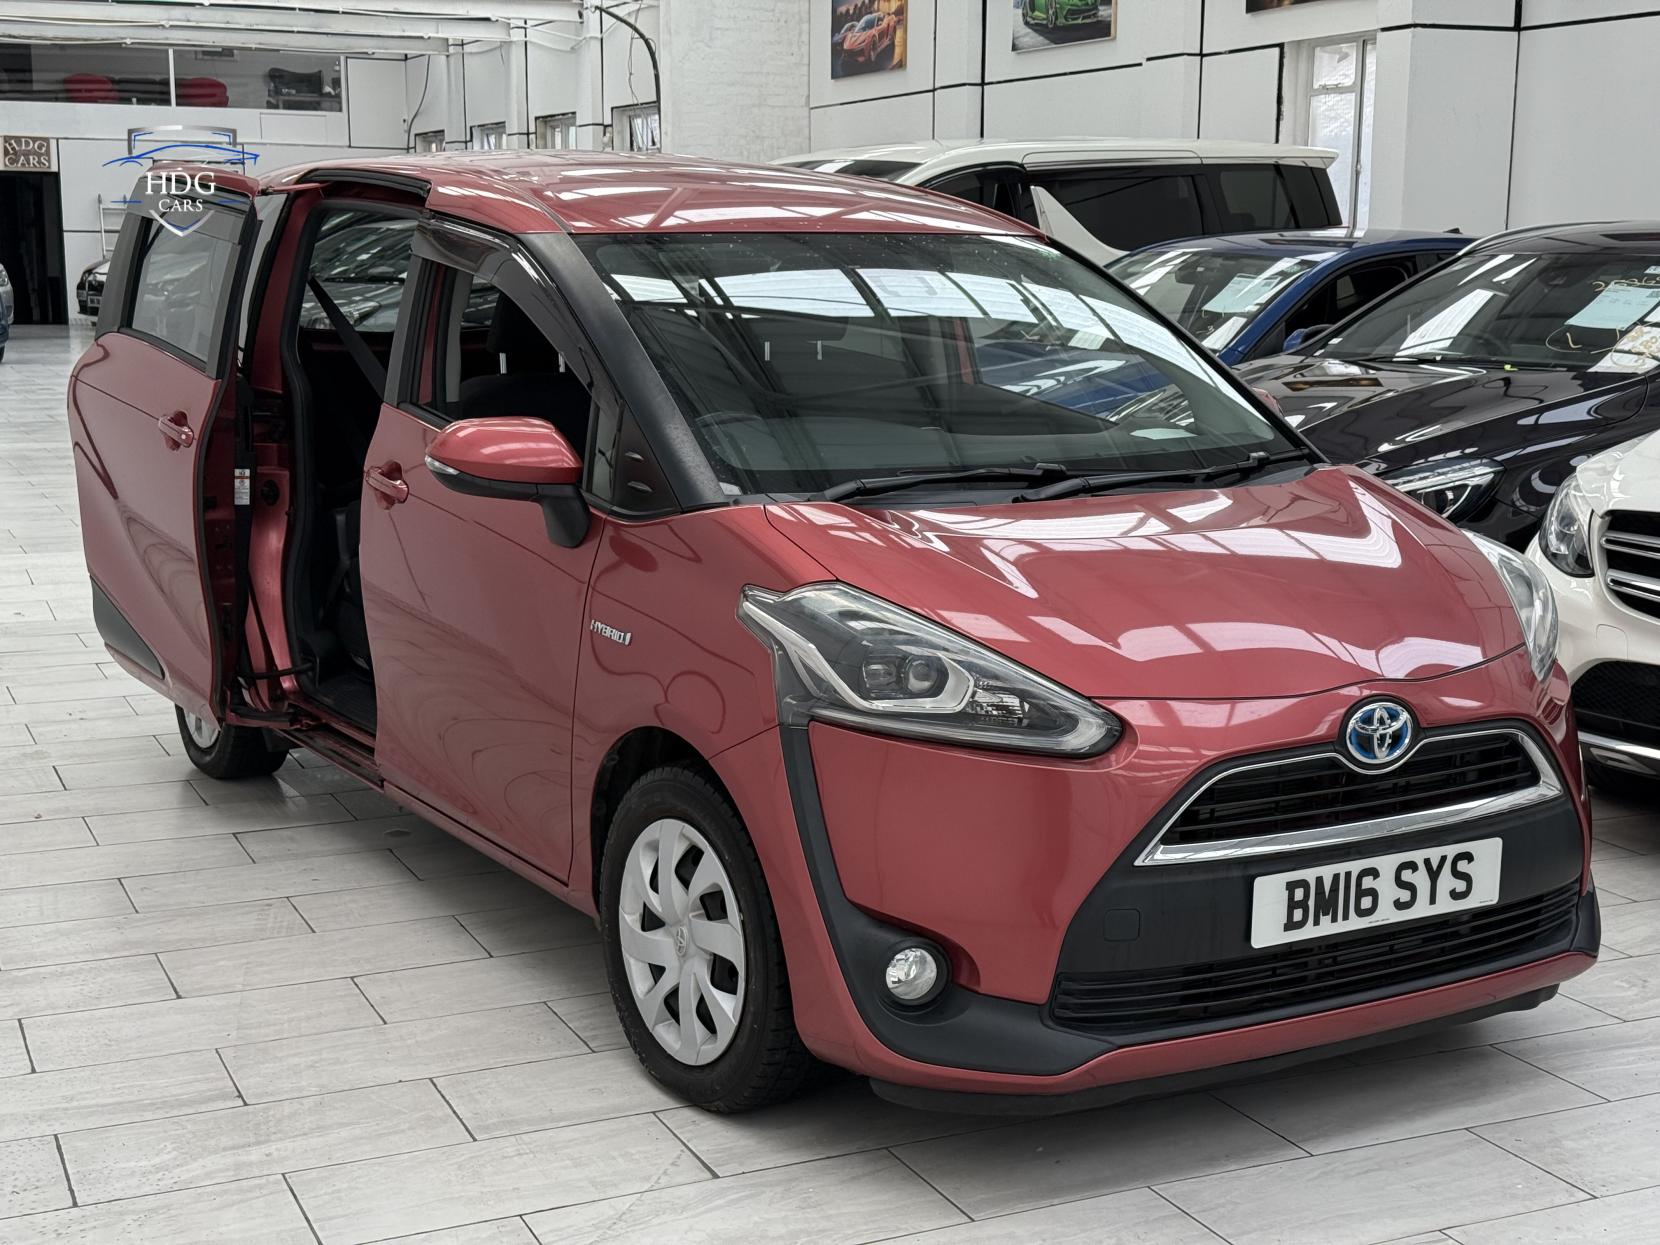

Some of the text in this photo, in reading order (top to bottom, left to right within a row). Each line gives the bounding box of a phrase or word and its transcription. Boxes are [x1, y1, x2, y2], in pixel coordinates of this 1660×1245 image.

[4, 138, 47, 153] HDG
[5, 155, 49, 168] CARS
[590, 619, 625, 643] HYBRID
[1283, 851, 1475, 933] BM16 SYS
